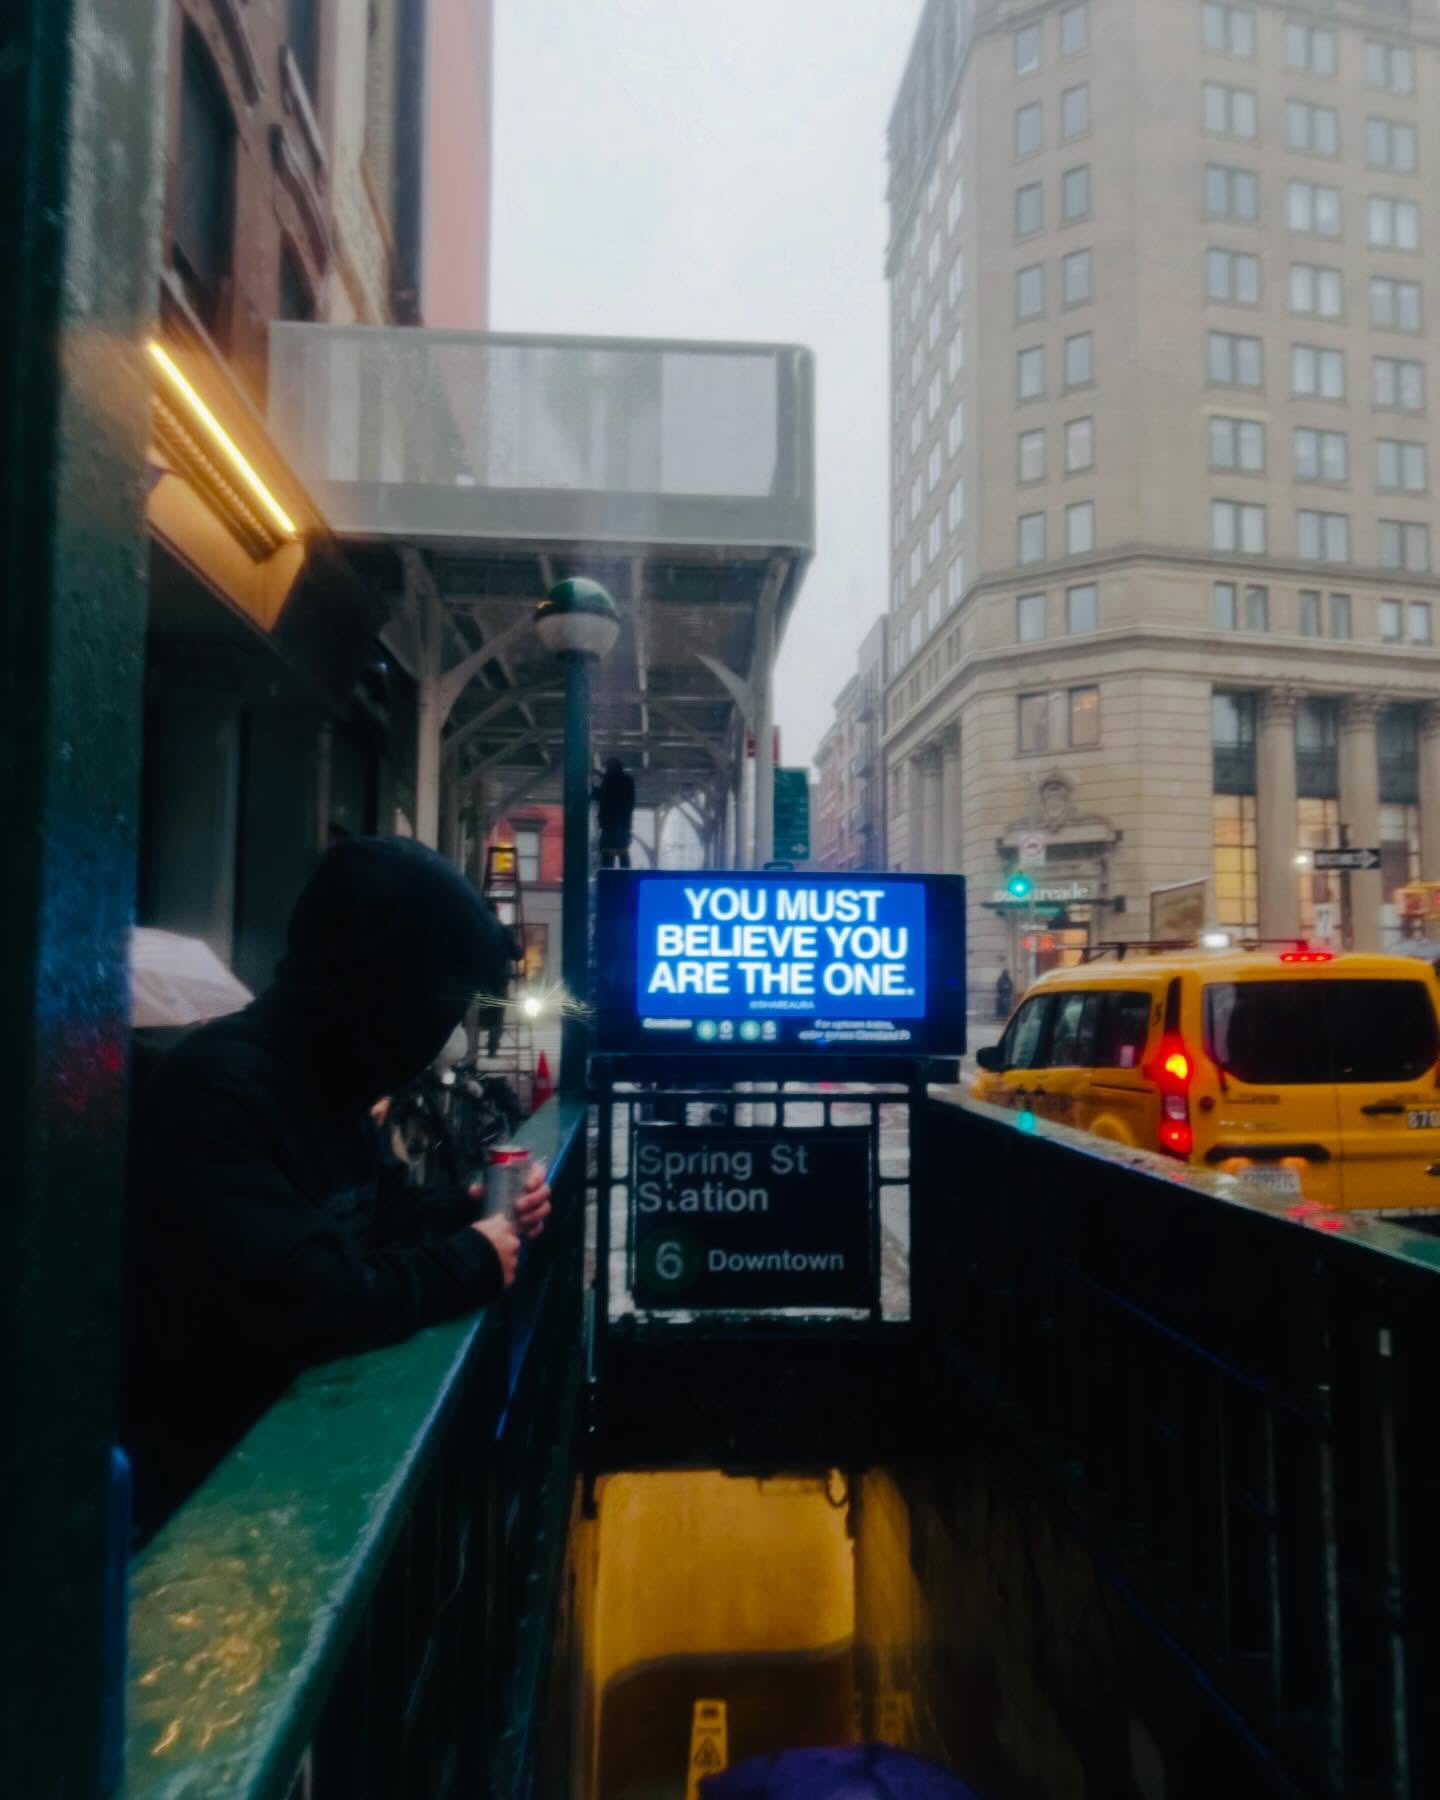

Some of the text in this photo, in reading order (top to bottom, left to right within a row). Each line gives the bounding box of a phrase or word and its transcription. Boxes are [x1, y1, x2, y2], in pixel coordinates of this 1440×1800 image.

[685, 888, 884, 922] YOU MUST
[657, 925, 908, 959] BELIEVE YOU
[648, 962, 915, 996] ARE THE ONE.
[639, 1145, 808, 1180] Spring St
[656, 1241, 844, 1279] 6 Downtown
